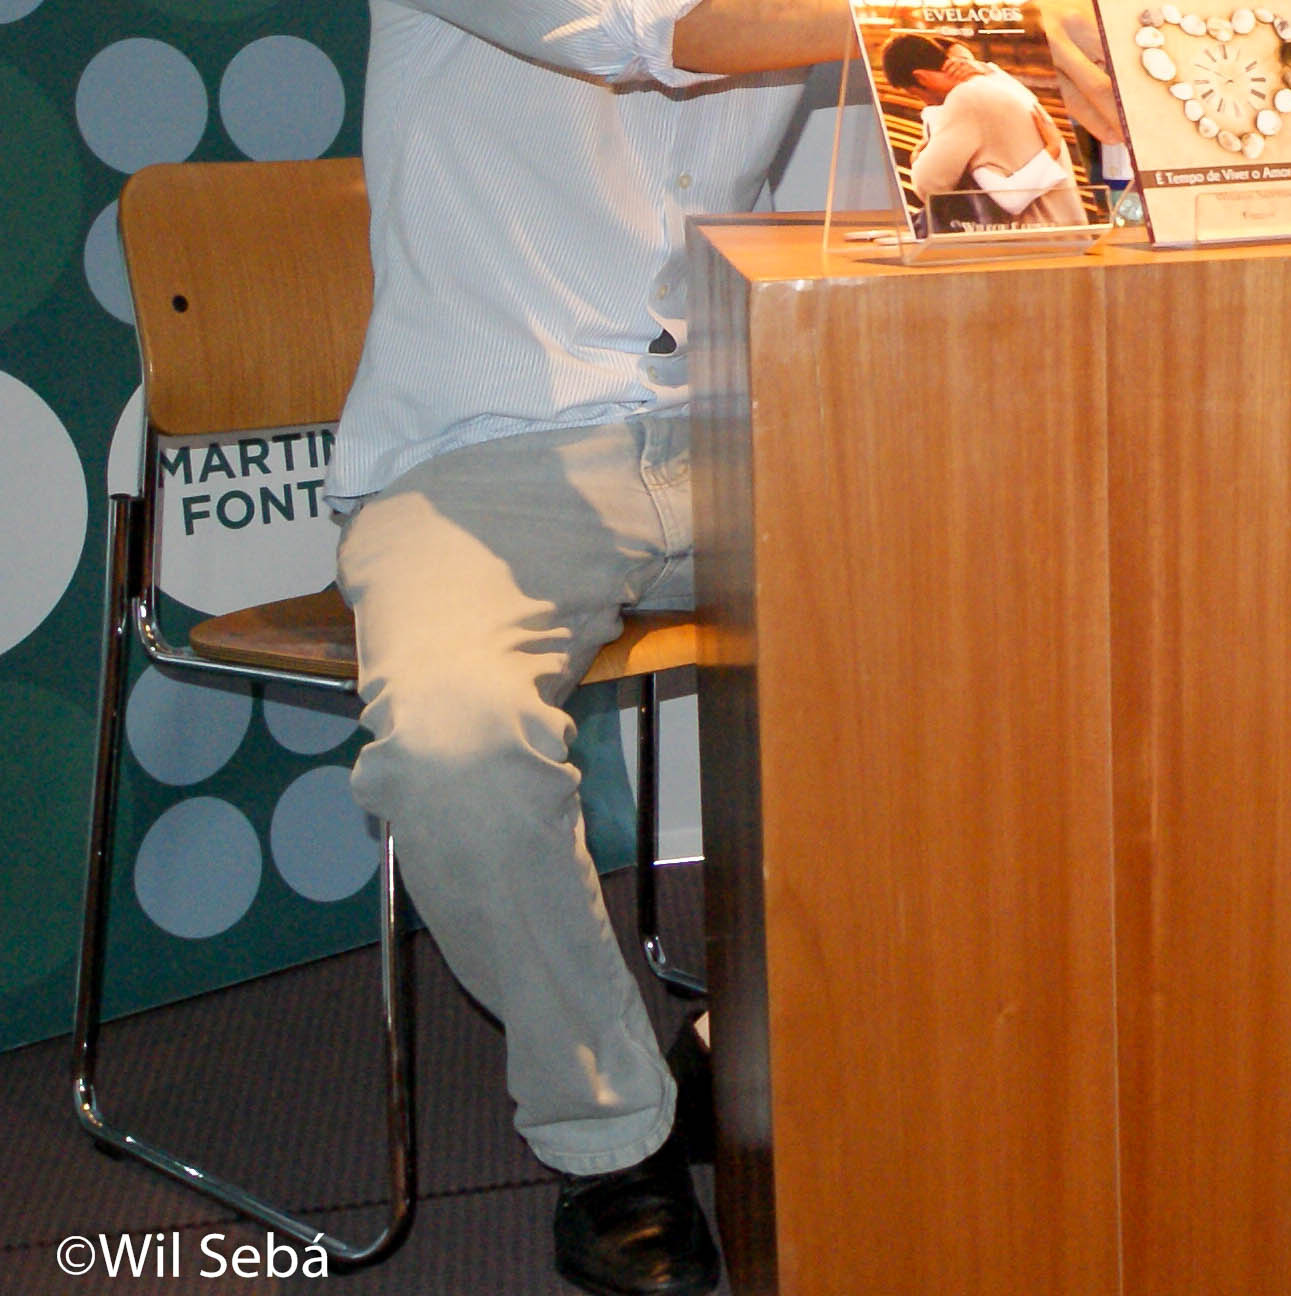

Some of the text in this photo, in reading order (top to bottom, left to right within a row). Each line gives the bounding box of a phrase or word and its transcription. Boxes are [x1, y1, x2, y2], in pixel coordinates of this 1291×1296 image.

[1166, 171, 1204, 185] Tempo
[1206, 169, 1221, 181] de
[1222, 168, 1250, 180] Viver
[1251, 170, 1261, 179] o
